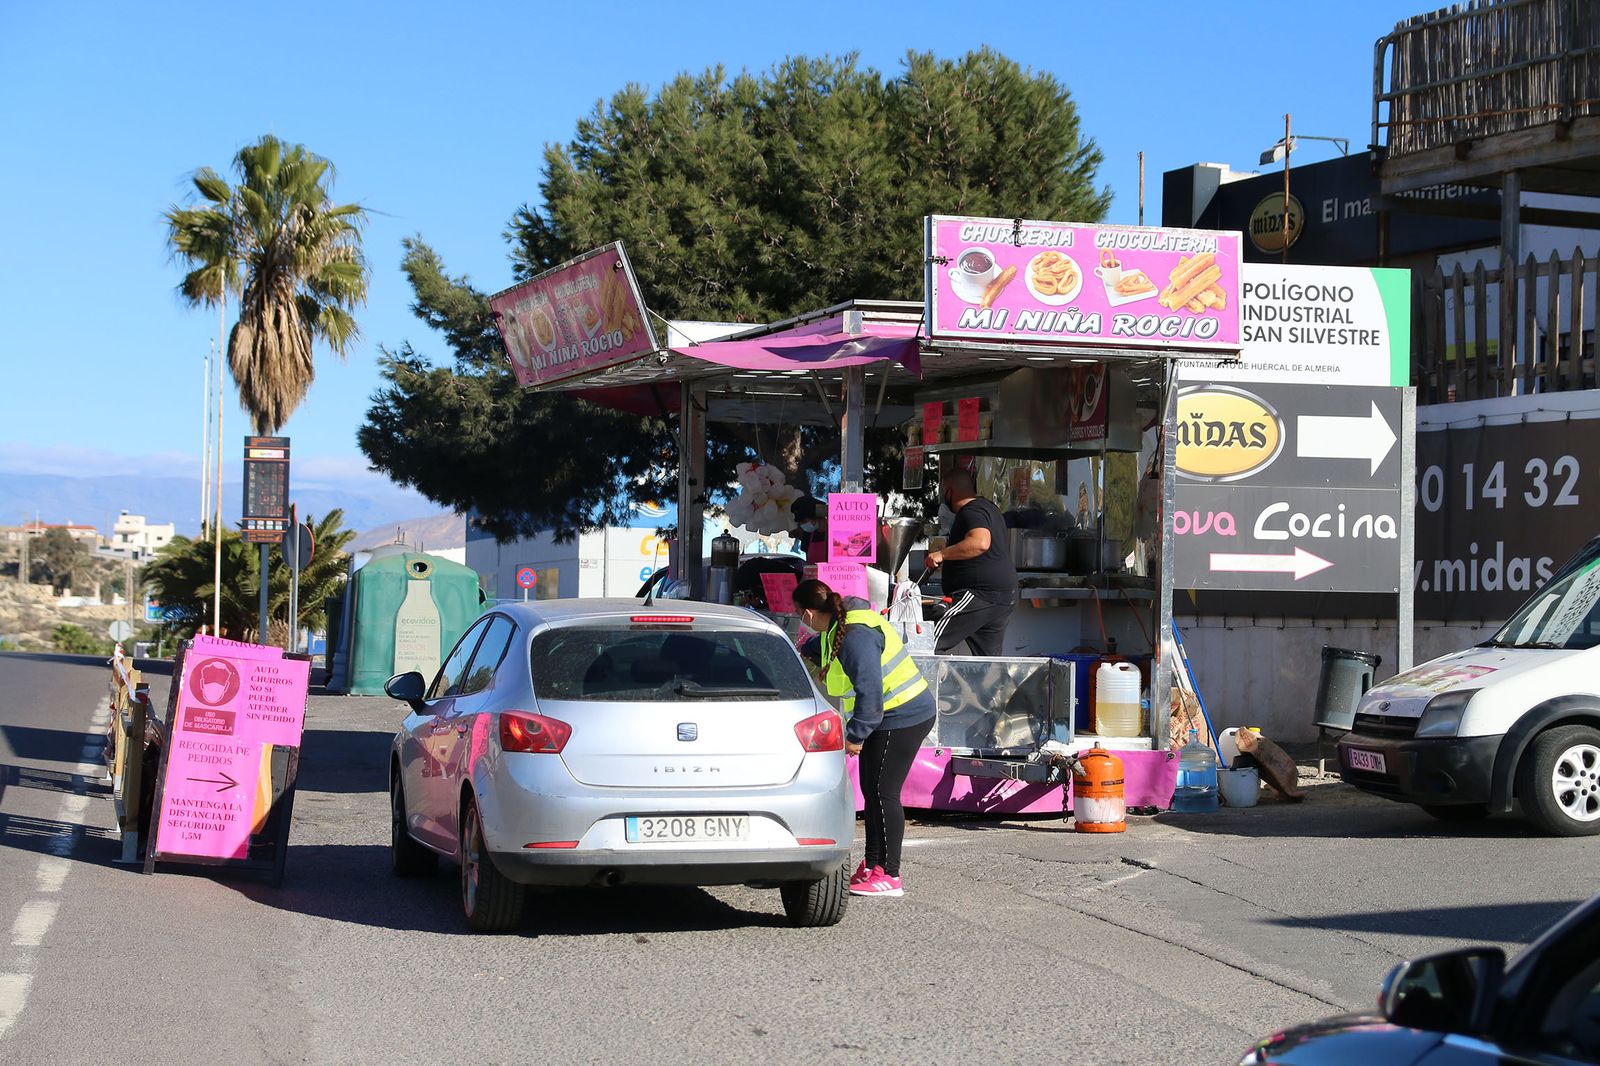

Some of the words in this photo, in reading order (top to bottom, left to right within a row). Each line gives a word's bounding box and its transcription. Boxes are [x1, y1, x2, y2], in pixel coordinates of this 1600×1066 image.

[1322, 197, 1338, 223] El
[960, 223, 1074, 247] CHURRERIA
[1094, 231, 1218, 254] CHOCOLATERIA
[1242, 278, 1354, 303] POLÍGONO
[1242, 305, 1354, 325] INDUSTRIAL
[958, 308, 1010, 330] MI
[1015, 306, 1103, 335] NIÑA
[1111, 313, 1219, 340] ROCIO
[1243, 325, 1282, 343] SAN
[1289, 327, 1381, 347] SILVESTRE
[531, 354, 547, 369] MI
[581, 330, 625, 357] ROCIO
[1237, 361, 1249, 370] DE
[1291, 364, 1303, 372] DE
[1415, 464, 1445, 513] 0
[1462, 460, 1507, 510] 14
[1523, 455, 1580, 508] 32
[835, 501, 869, 511] AUTO
[1253, 501, 1398, 540] Cocina
[401, 616, 436, 625] ecovidrio
[253, 665, 279, 675] AUTO
[250, 675, 294, 686] CHURROS
[249, 684, 263, 693] NO
[263, 684, 276, 694] SE
[248, 694, 278, 703] PUEDE
[247, 703, 288, 714] ATENDER
[246, 712, 261, 721] SIN
[261, 713, 296, 724] PEDIDO
[194, 722, 233, 733] MASCARILLA
[178, 740, 234, 755] RECOGIDA
[235, 746, 250, 757] DE
[187, 753, 233, 766] PEDIDOS
[170, 798, 228, 811] MANTENGA
[229, 802, 243, 812] LA
[168, 809, 224, 821] DISTANCIA
[224, 812, 237, 822] DE
[167, 819, 226, 832] SEGURIDAD
[642, 818, 696, 838] 3208
[704, 817, 743, 837] GNY
[181, 831, 202, 841] 1,5M
